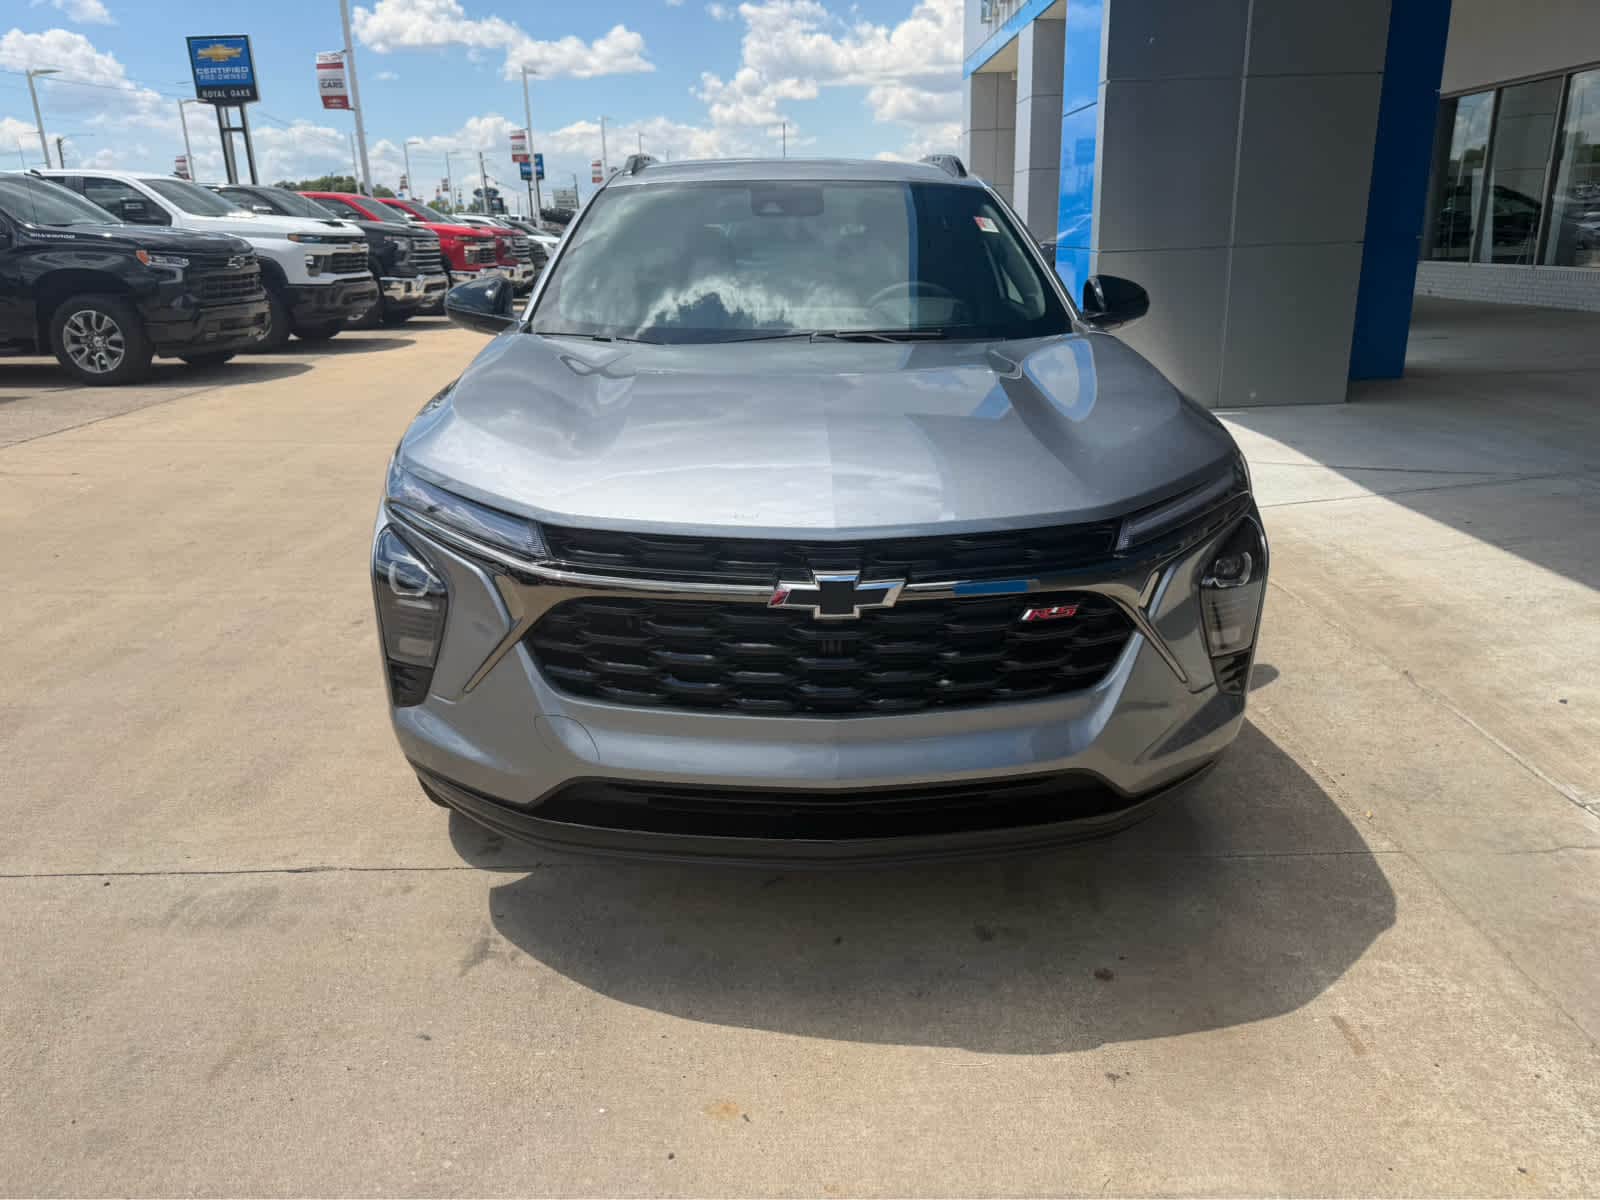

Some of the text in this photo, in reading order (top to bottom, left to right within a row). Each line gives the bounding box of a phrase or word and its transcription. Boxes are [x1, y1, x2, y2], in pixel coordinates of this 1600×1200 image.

[196, 66, 249, 74] CERTIFIED
[202, 89, 251, 98] ROYAL OAKS
[1021, 604, 1080, 622] RS
